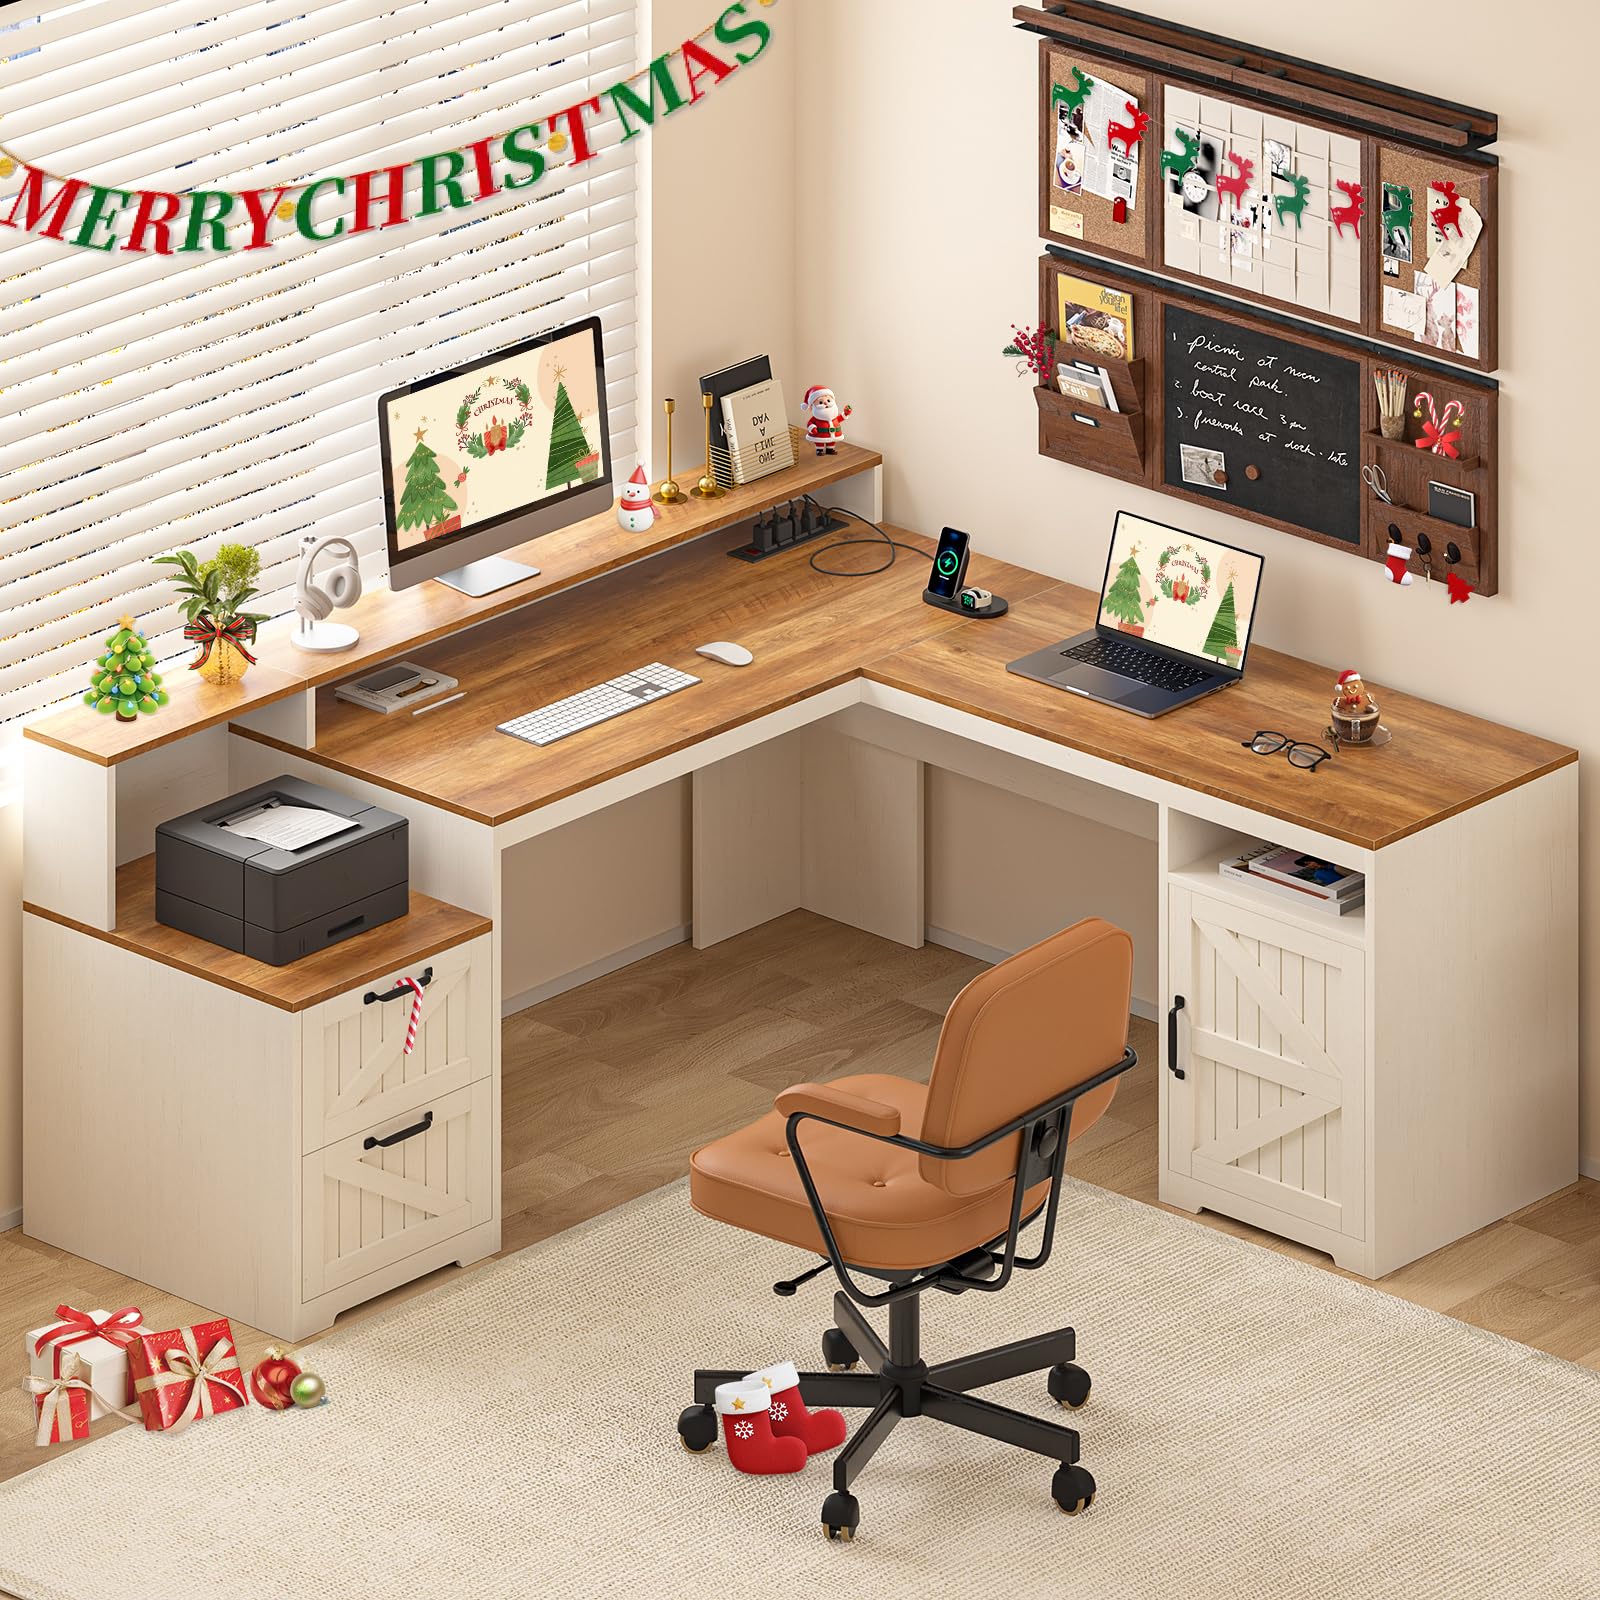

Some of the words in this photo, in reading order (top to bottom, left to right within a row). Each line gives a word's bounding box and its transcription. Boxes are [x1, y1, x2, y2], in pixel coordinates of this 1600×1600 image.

[1193, 360, 1237, 382] central
[1257, 355, 1278, 369] at
[1190, 379, 1226, 406] boat
[1232, 400, 1269, 420] race
[1258, 432, 1277, 442] at
